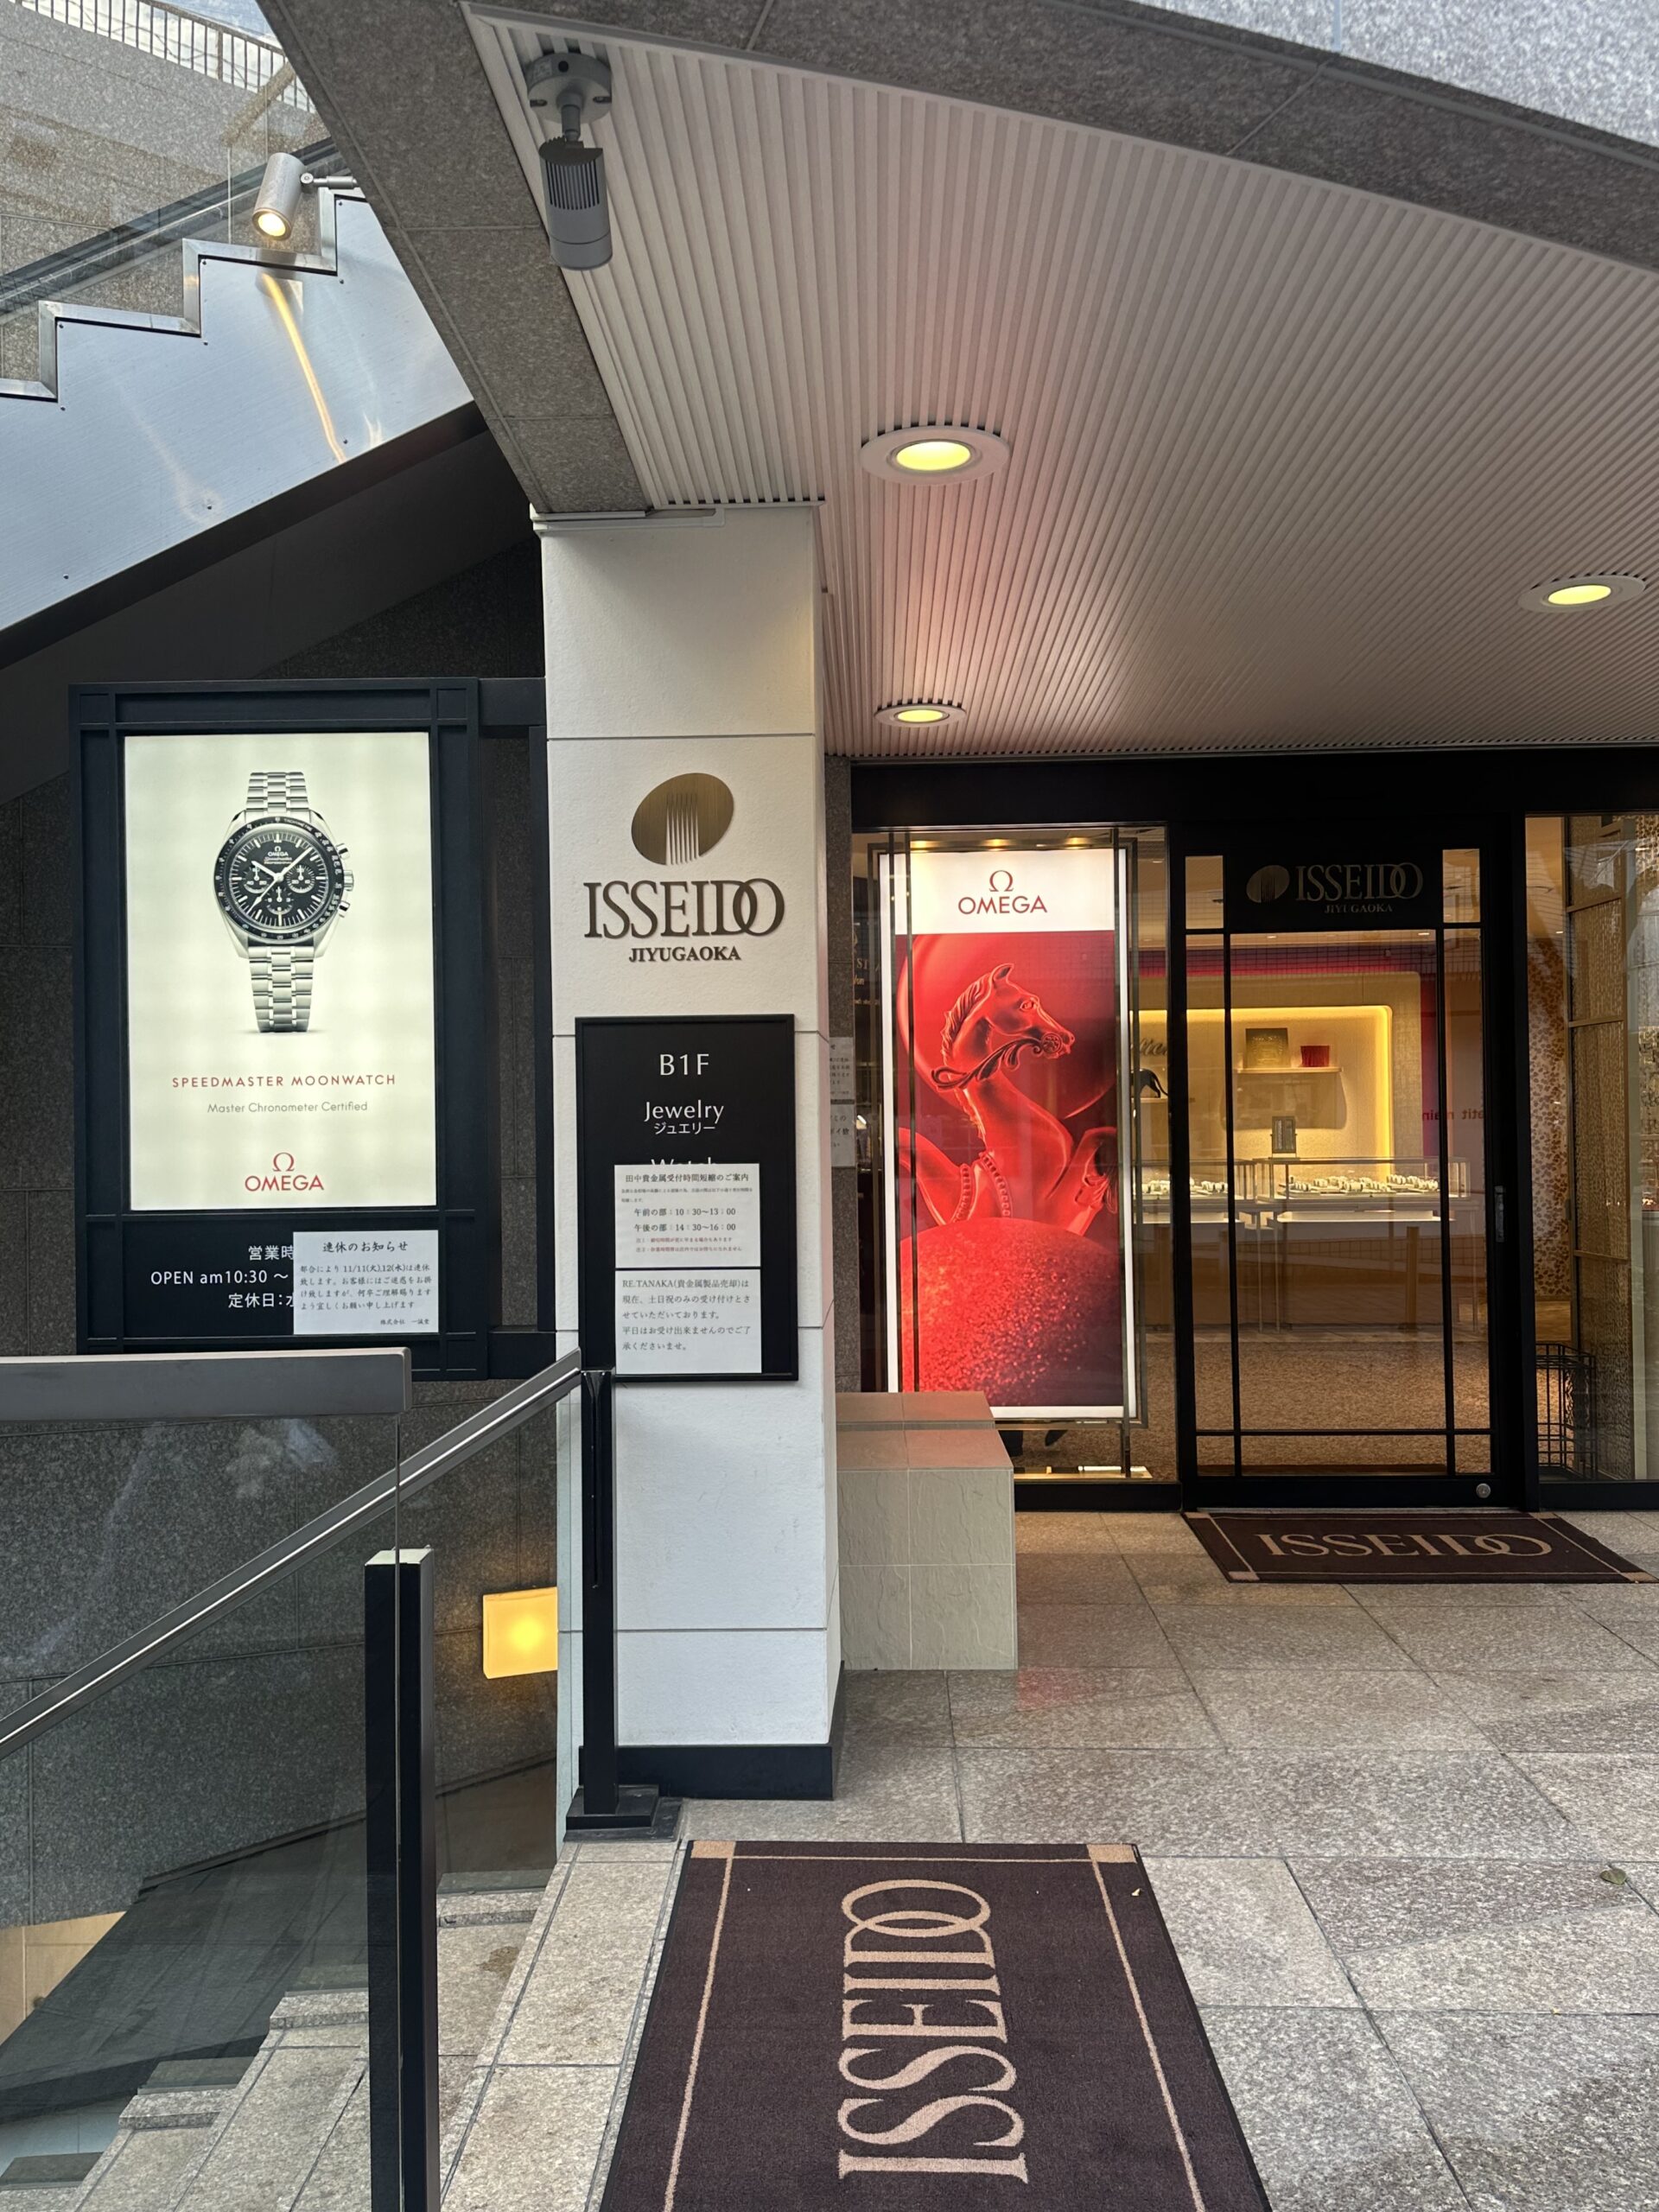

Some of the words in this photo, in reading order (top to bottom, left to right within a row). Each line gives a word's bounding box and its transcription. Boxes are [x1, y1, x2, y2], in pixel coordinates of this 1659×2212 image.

[1295, 862, 1424, 902] ISSEIDO
[582, 878, 785, 939] ISSEIDO
[958, 895, 1047, 915] OMEGA
[1325, 903, 1393, 913] JIYUGAOKA
[629, 946, 741, 963] JIYUGAOKA
[659, 1053, 709, 1076] B1F
[172, 1076, 284, 1088] SPEEDMASTER
[290, 1074, 396, 1086] MOONWATCH
[207, 1103, 245, 1113] Master
[248, 1102, 318, 1113] Chronometer
[321, 1101, 368, 1112] Certified
[644, 1099, 724, 1123] Jewelry
[653, 1122, 716, 1135] ジュエリー
[245, 1175, 324, 1192] OMEGA
[625, 1173, 749, 1183] 田中貴金属受付時間短縮のご案内
[322, 1241, 409, 1254] 連休のお知らせ
[150, 1271, 194, 1285] OPEN
[200, 1270, 267, 1284] am10:30
[622, 1294, 751, 1305] 現在、土日祝のみの受け付けとさ
[622, 1311, 720, 1319] せていただいております。
[622, 1325, 752, 1335] 平日はお受け出来ませんのでご了
[622, 1341, 687, 1351] 承くださいませ。
[1255, 1533, 1552, 1557] ISSEIDO
[837, 1878, 1029, 2185] ISSEIDO
